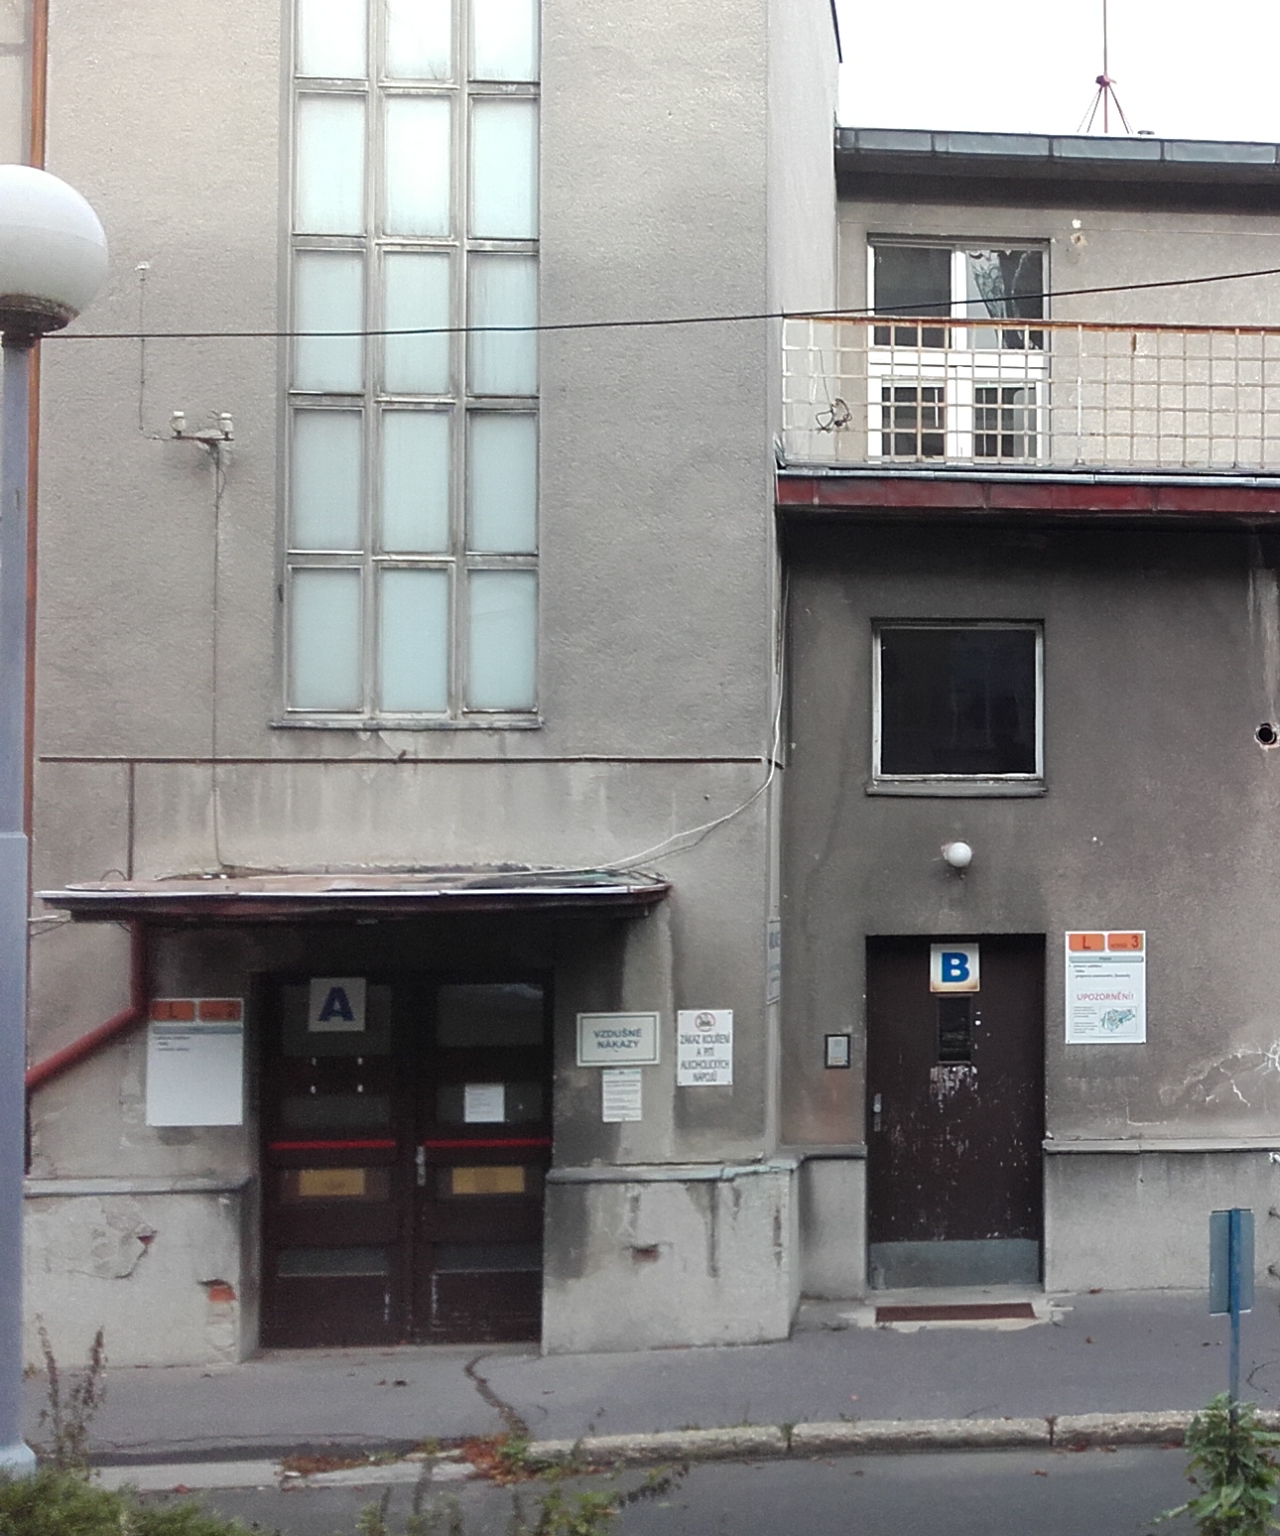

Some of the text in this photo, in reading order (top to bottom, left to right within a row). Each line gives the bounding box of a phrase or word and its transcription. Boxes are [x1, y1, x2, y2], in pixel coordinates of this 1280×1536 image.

[1082, 935, 1092, 950] L
[1131, 935, 1139, 949] 3
[942, 952, 970, 983] B
[318, 987, 355, 1021] A
